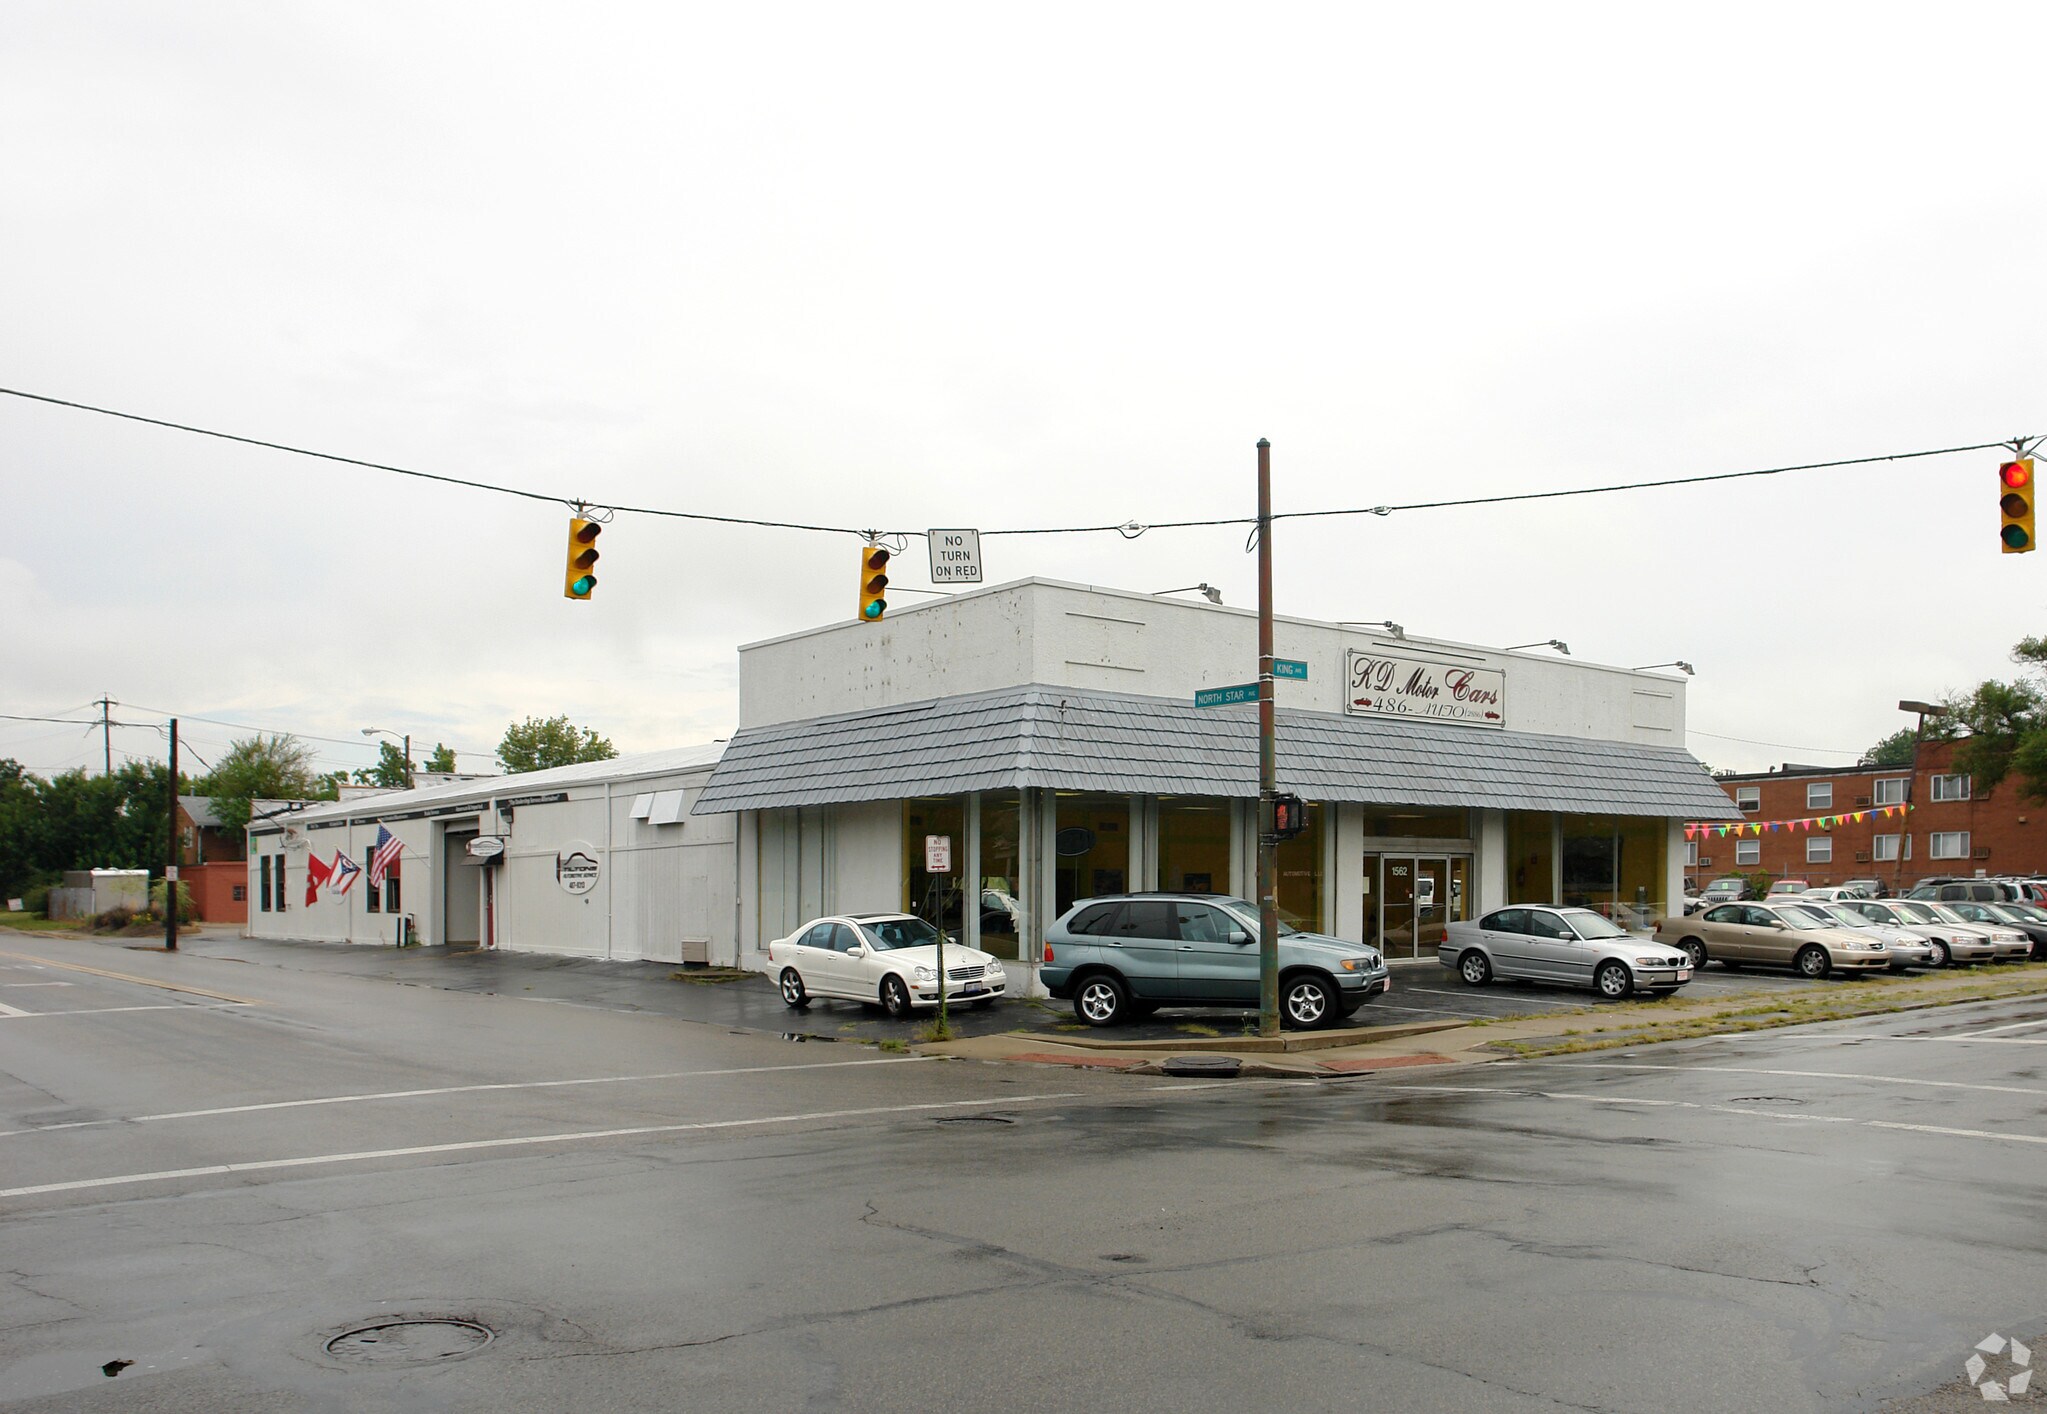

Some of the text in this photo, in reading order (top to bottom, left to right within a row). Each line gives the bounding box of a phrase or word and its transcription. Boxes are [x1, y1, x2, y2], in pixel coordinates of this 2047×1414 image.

[945, 536, 962, 546] NO
[940, 551, 970, 561] TURN
[936, 565, 977, 576] ON RED
[1276, 663, 1293, 675] KING
[1352, 657, 1498, 705] KD Motor Cars
[1198, 694, 1222, 705] NORTH
[1225, 690, 1244, 701] STAR
[1391, 867, 1408, 876] 1562
